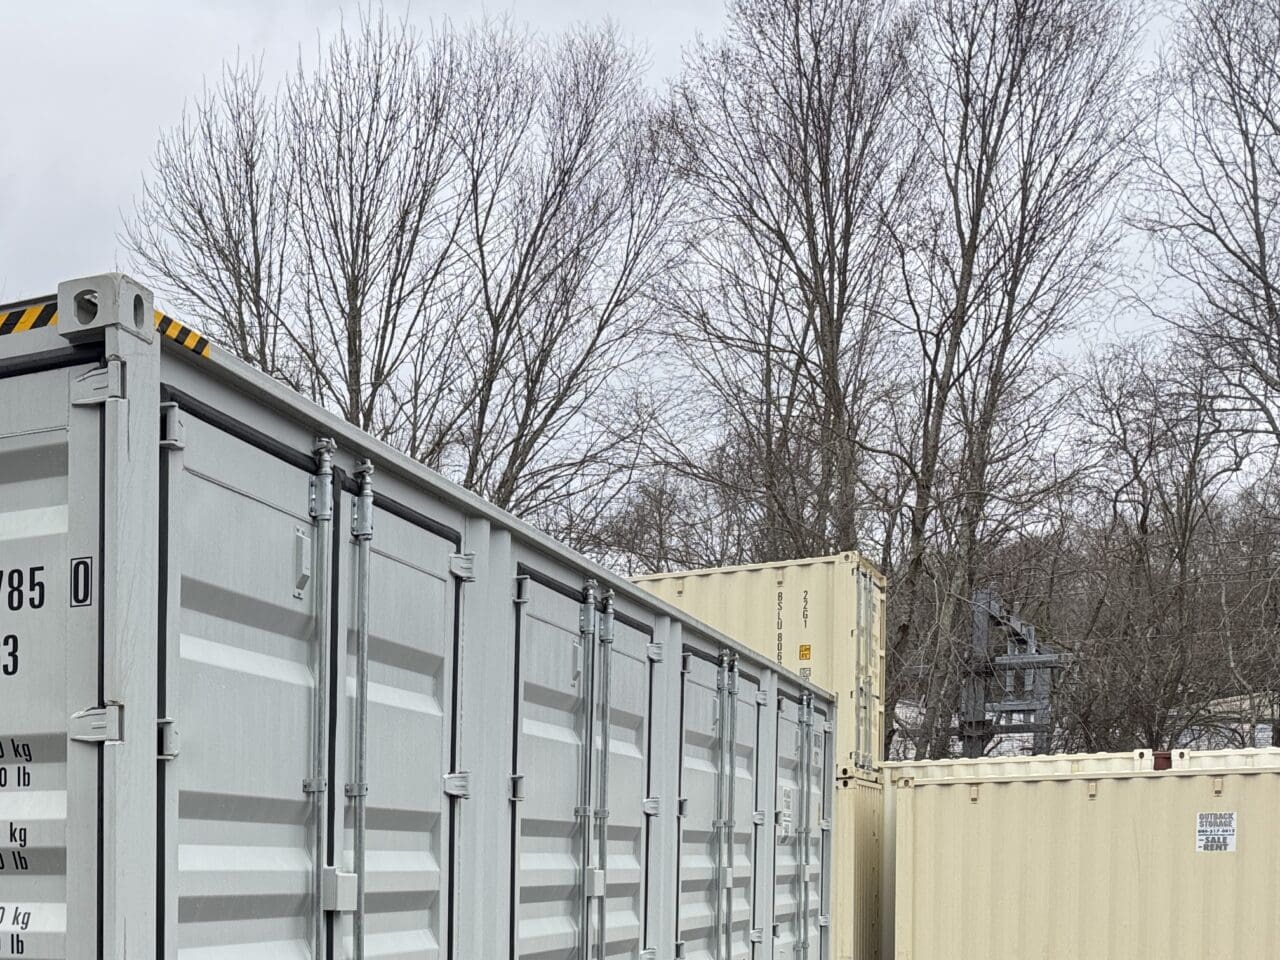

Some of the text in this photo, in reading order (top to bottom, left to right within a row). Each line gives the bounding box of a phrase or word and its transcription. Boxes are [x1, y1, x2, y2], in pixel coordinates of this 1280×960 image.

[72, 560, 90, 604] 0
[10, 738, 32, 762] kg
[17, 766, 31, 788] lb
[9, 822, 28, 847] kg
[1203, 843, 1229, 851] RENT
[12, 851, 29, 870] lb
[12, 906, 31, 930] kg
[10, 933, 25, 954] lb
